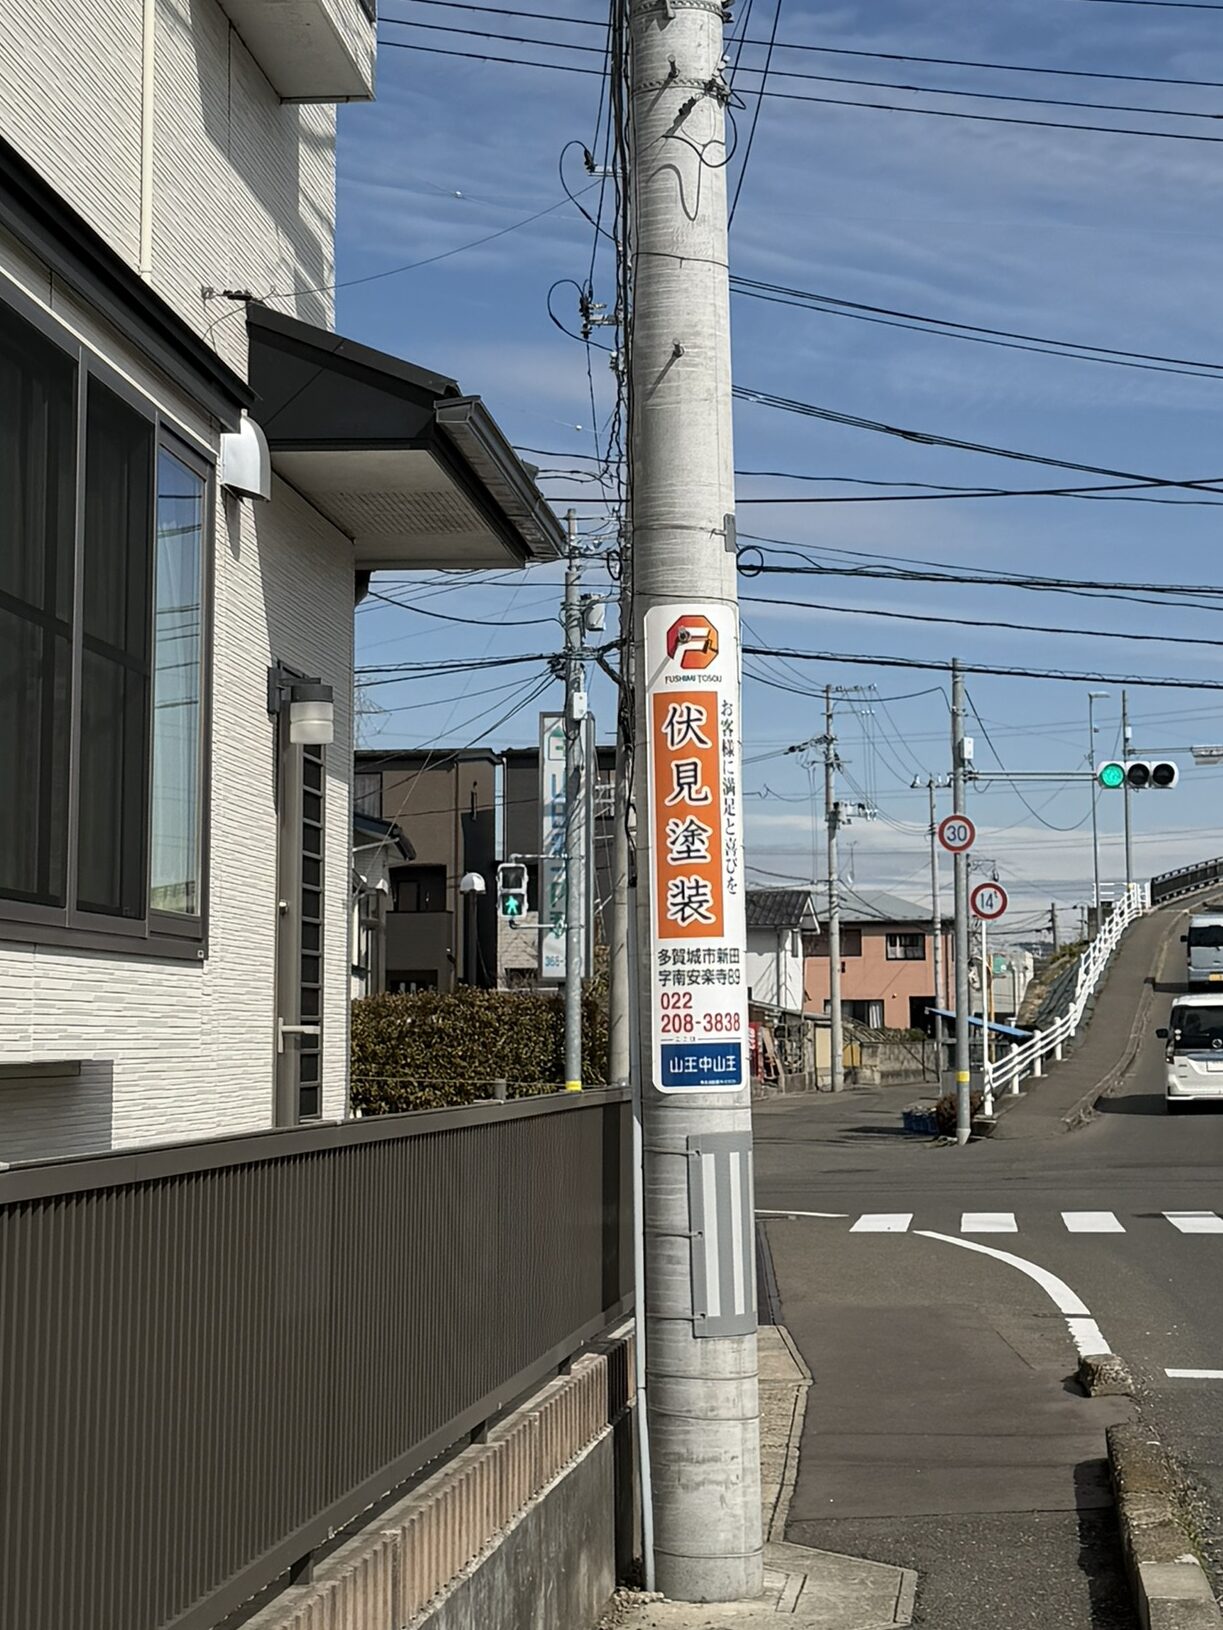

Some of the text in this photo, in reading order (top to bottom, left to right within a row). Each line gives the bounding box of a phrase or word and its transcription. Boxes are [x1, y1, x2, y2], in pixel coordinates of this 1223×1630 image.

[665, 674, 722, 684] FUSHIMI TOSOU
[720, 699, 738, 895] お客様に満足と喜びを
[663, 703, 715, 926] 伏見塗装
[946, 825, 967, 842] 30
[657, 947, 741, 966] 多賀城市新田
[660, 991, 693, 1010] 022
[661, 1012, 741, 1033] 208-3838
[669, 1055, 737, 1073] 山王中山王
